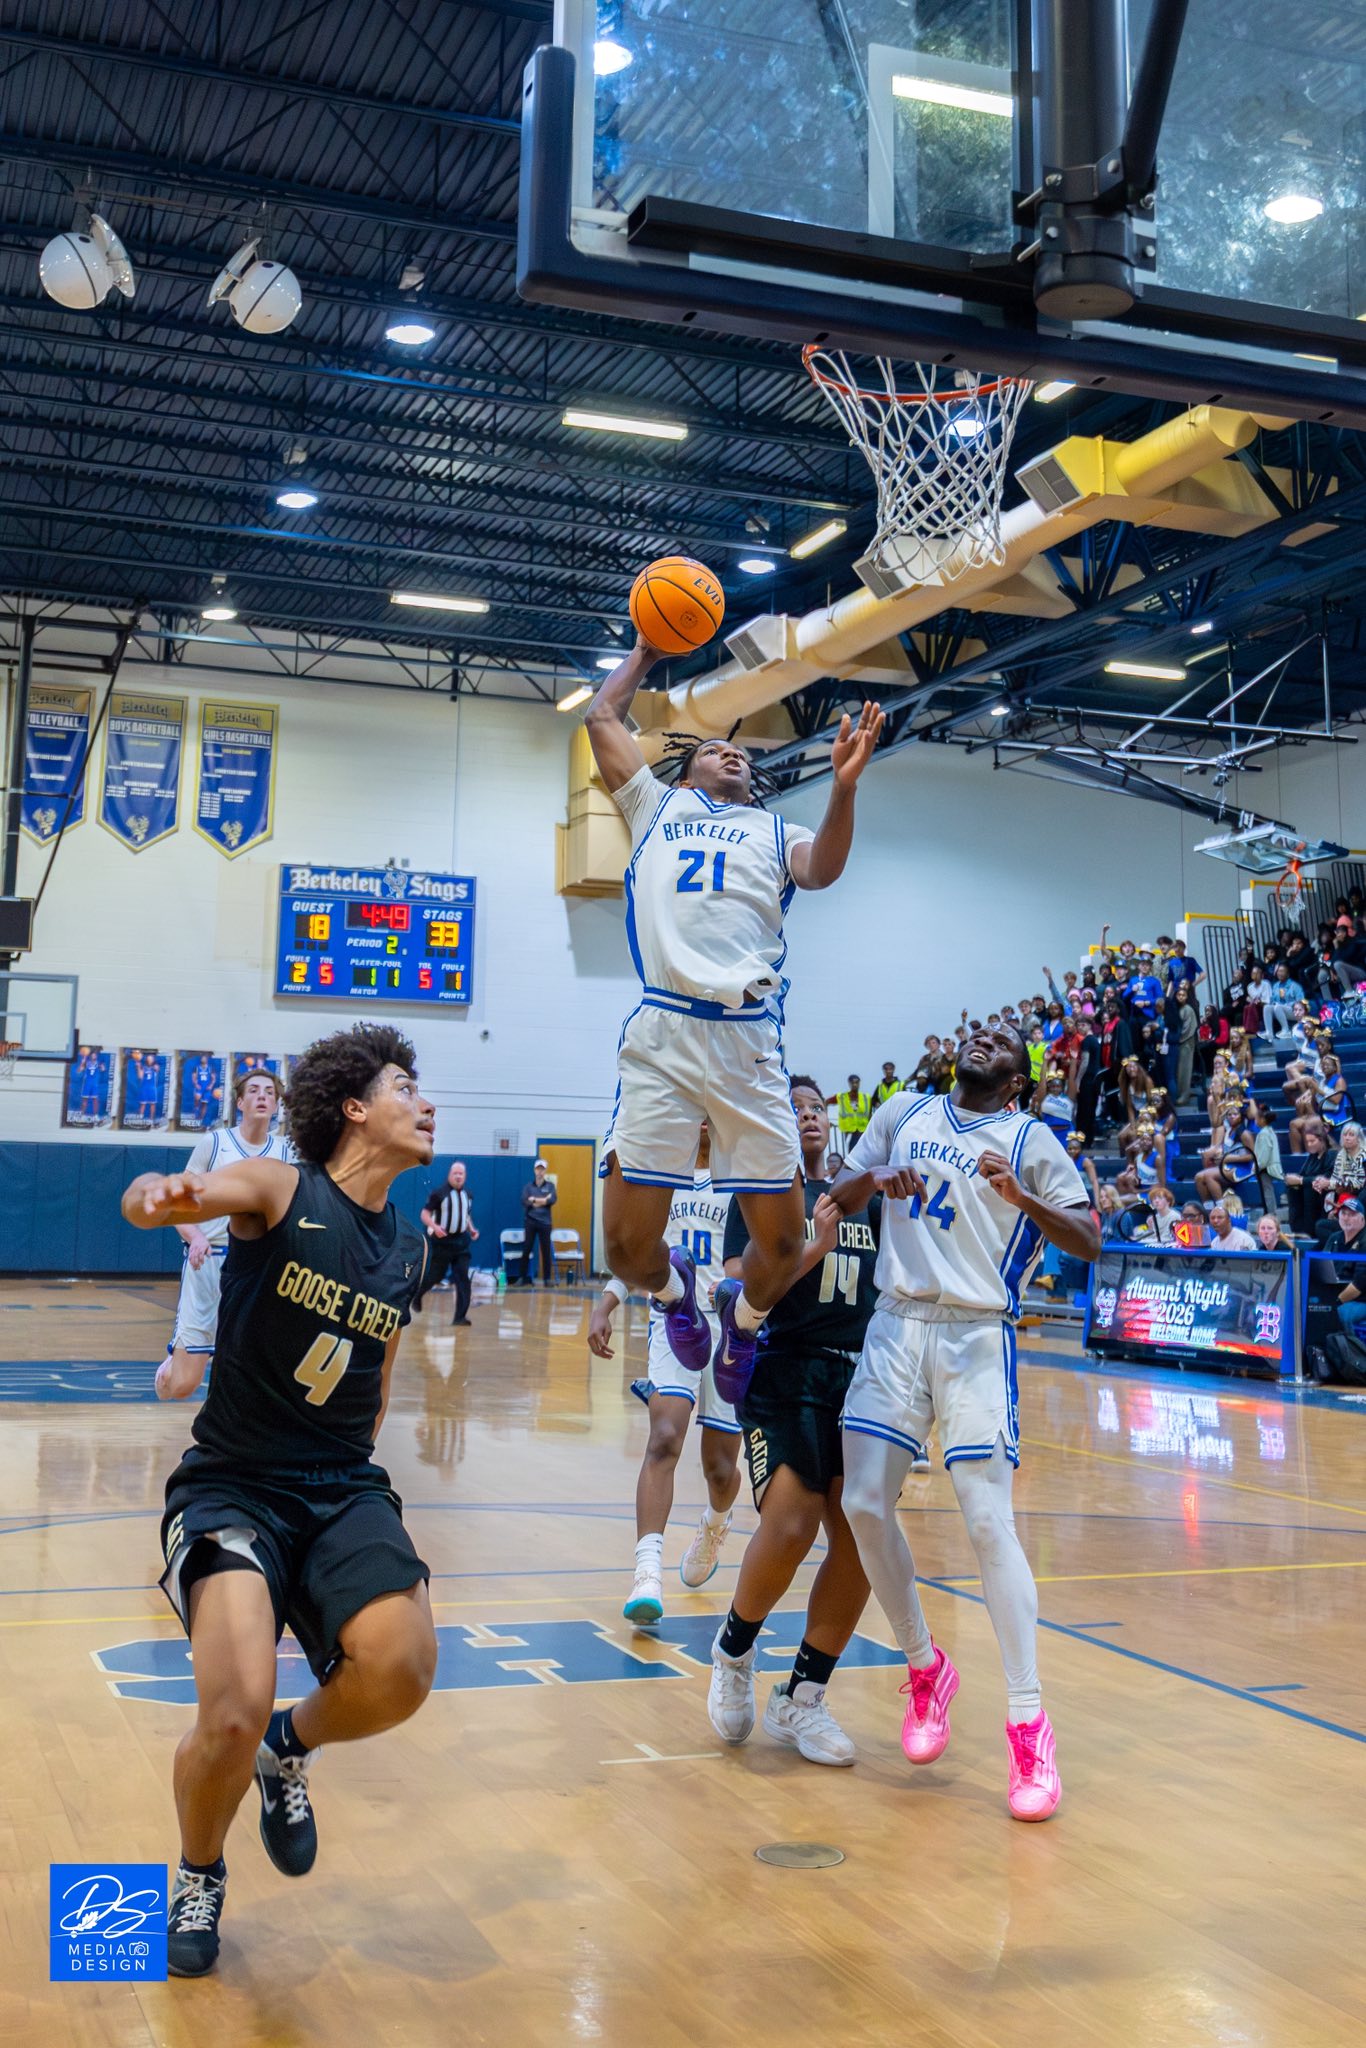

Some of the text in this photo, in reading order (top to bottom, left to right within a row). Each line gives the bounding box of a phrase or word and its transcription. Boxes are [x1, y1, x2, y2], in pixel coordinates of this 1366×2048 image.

[109, 720, 180, 737] BOYS BASKETBALL
[203, 729, 271, 745] GIRLS BASKETBALL
[663, 822, 750, 845] BERKELEY
[676, 850, 727, 894] 21
[289, 868, 469, 902] Berkeley Stags
[292, 901, 334, 913] GUEST
[361, 904, 409, 930] 4:49
[423, 909, 463, 921] STAGS
[309, 914, 331, 940] 18
[429, 921, 460, 947] 33
[346, 938, 383, 948] PERIOD
[386, 935, 399, 954] 2
[292, 962, 307, 983] 2
[319, 964, 335, 985] 5
[418, 969, 432, 989] 5
[670, 1201, 727, 1223] BERKELEY
[908, 1174, 957, 1231] 14
[818, 1251, 860, 1306] 14
[276, 1261, 350, 1323] GOOSE
[1125, 1275, 1229, 1311] Alumni Night
[1157, 1302, 1195, 1325] 2026
[1149, 1322, 1217, 1346] WELCOME HOME
[294, 1332, 354, 1407] 4
